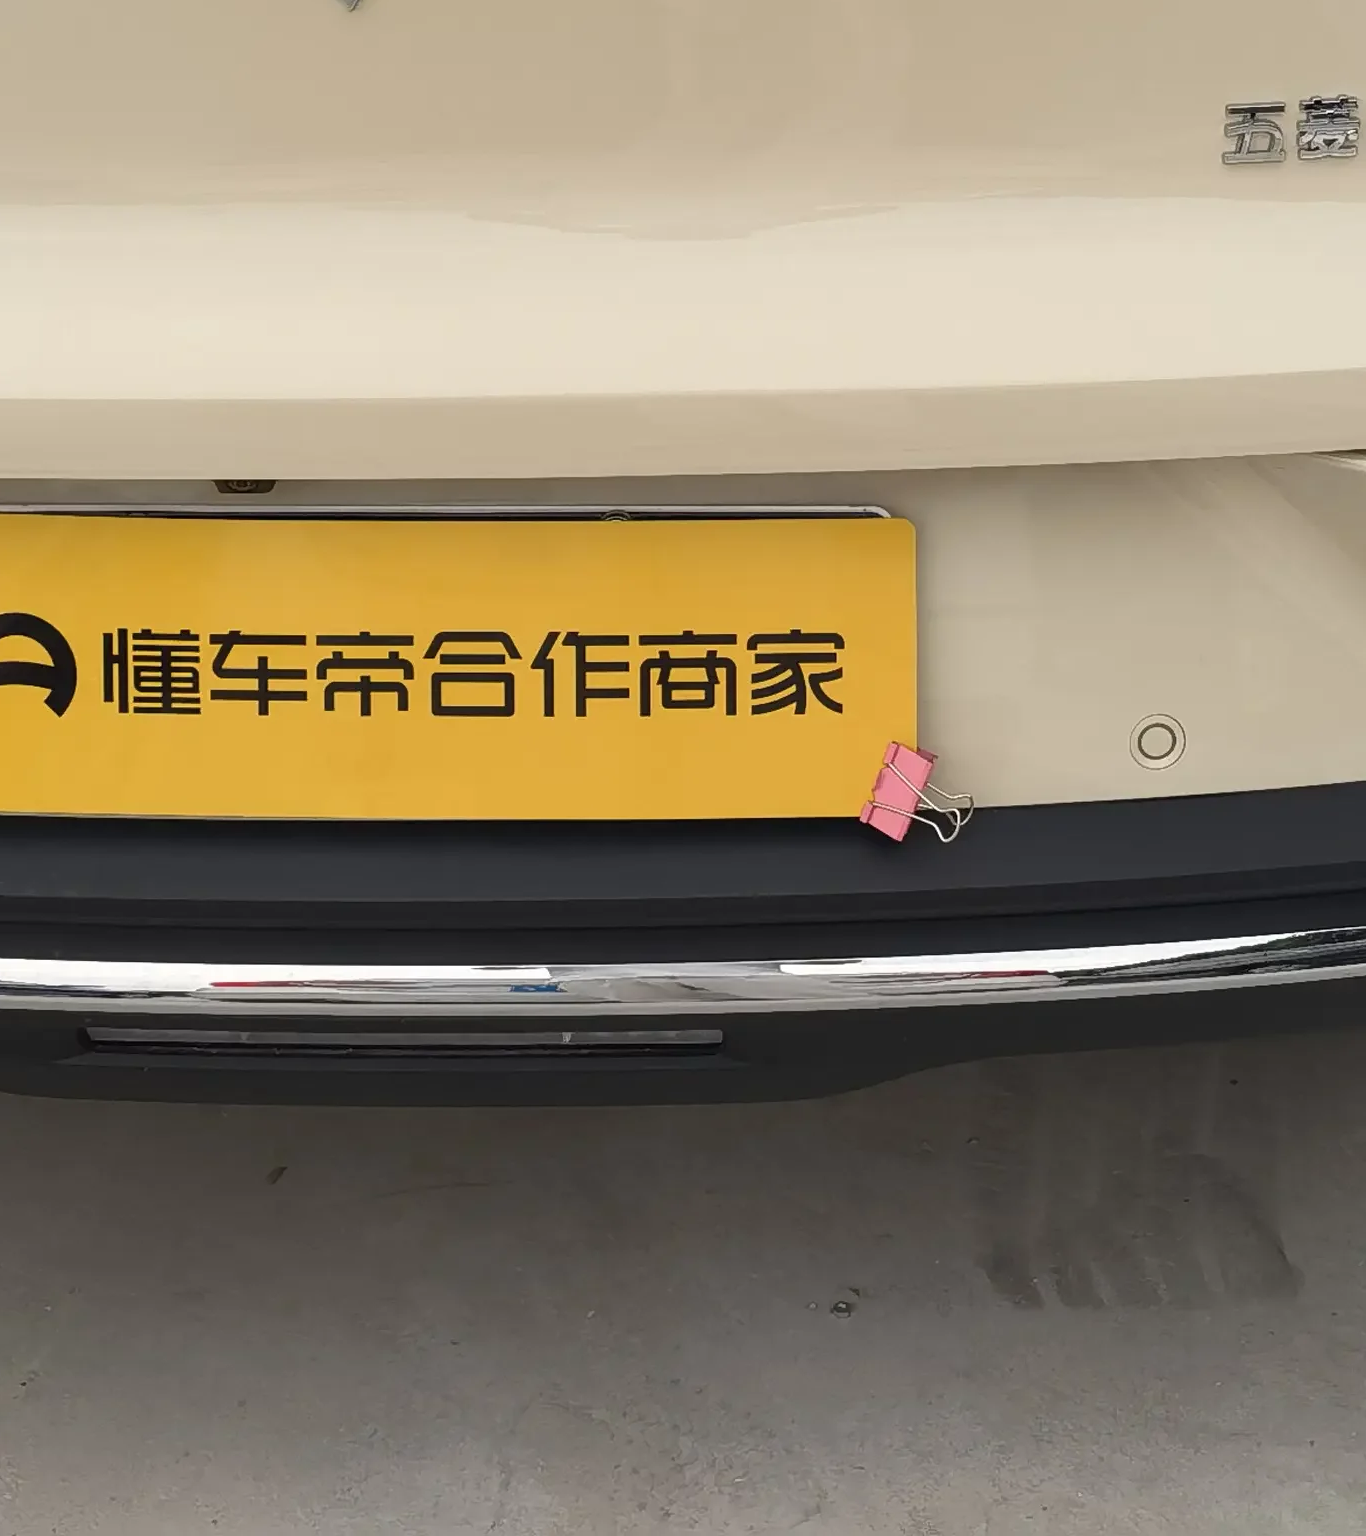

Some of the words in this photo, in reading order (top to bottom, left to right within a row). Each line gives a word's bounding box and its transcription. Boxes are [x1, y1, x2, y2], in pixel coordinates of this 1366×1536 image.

[101, 627, 844, 718] 懂车帝合作商家
